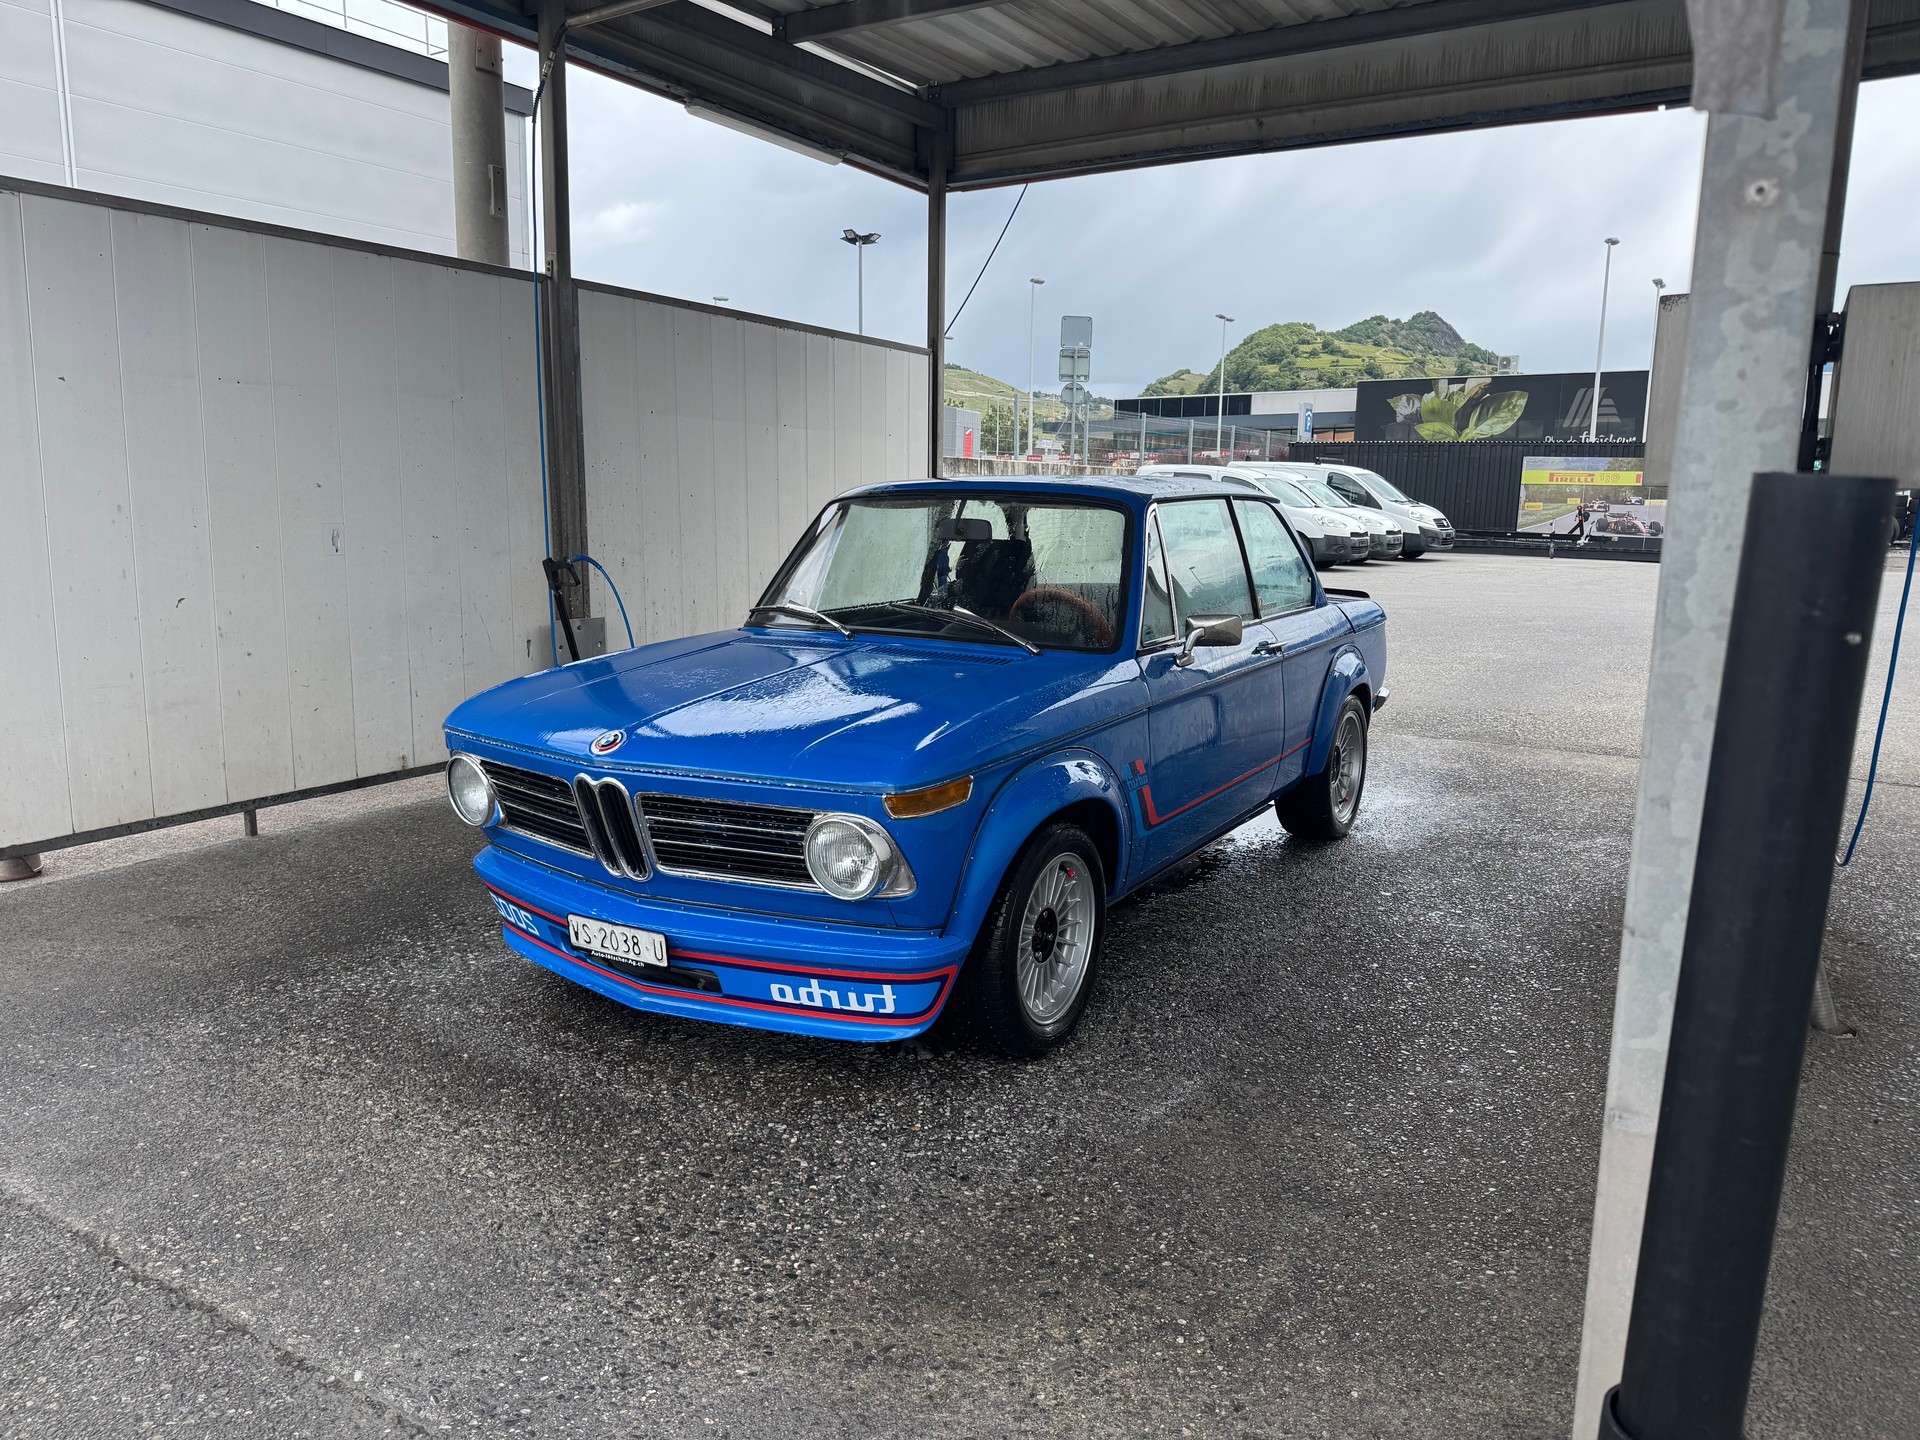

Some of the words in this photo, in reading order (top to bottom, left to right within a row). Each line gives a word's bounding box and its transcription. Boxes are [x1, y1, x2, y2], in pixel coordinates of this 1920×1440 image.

[1548, 473, 1595, 483] PIRELLI
[1126, 774, 1148, 791] turbo
[599, 927, 641, 956] 2038
